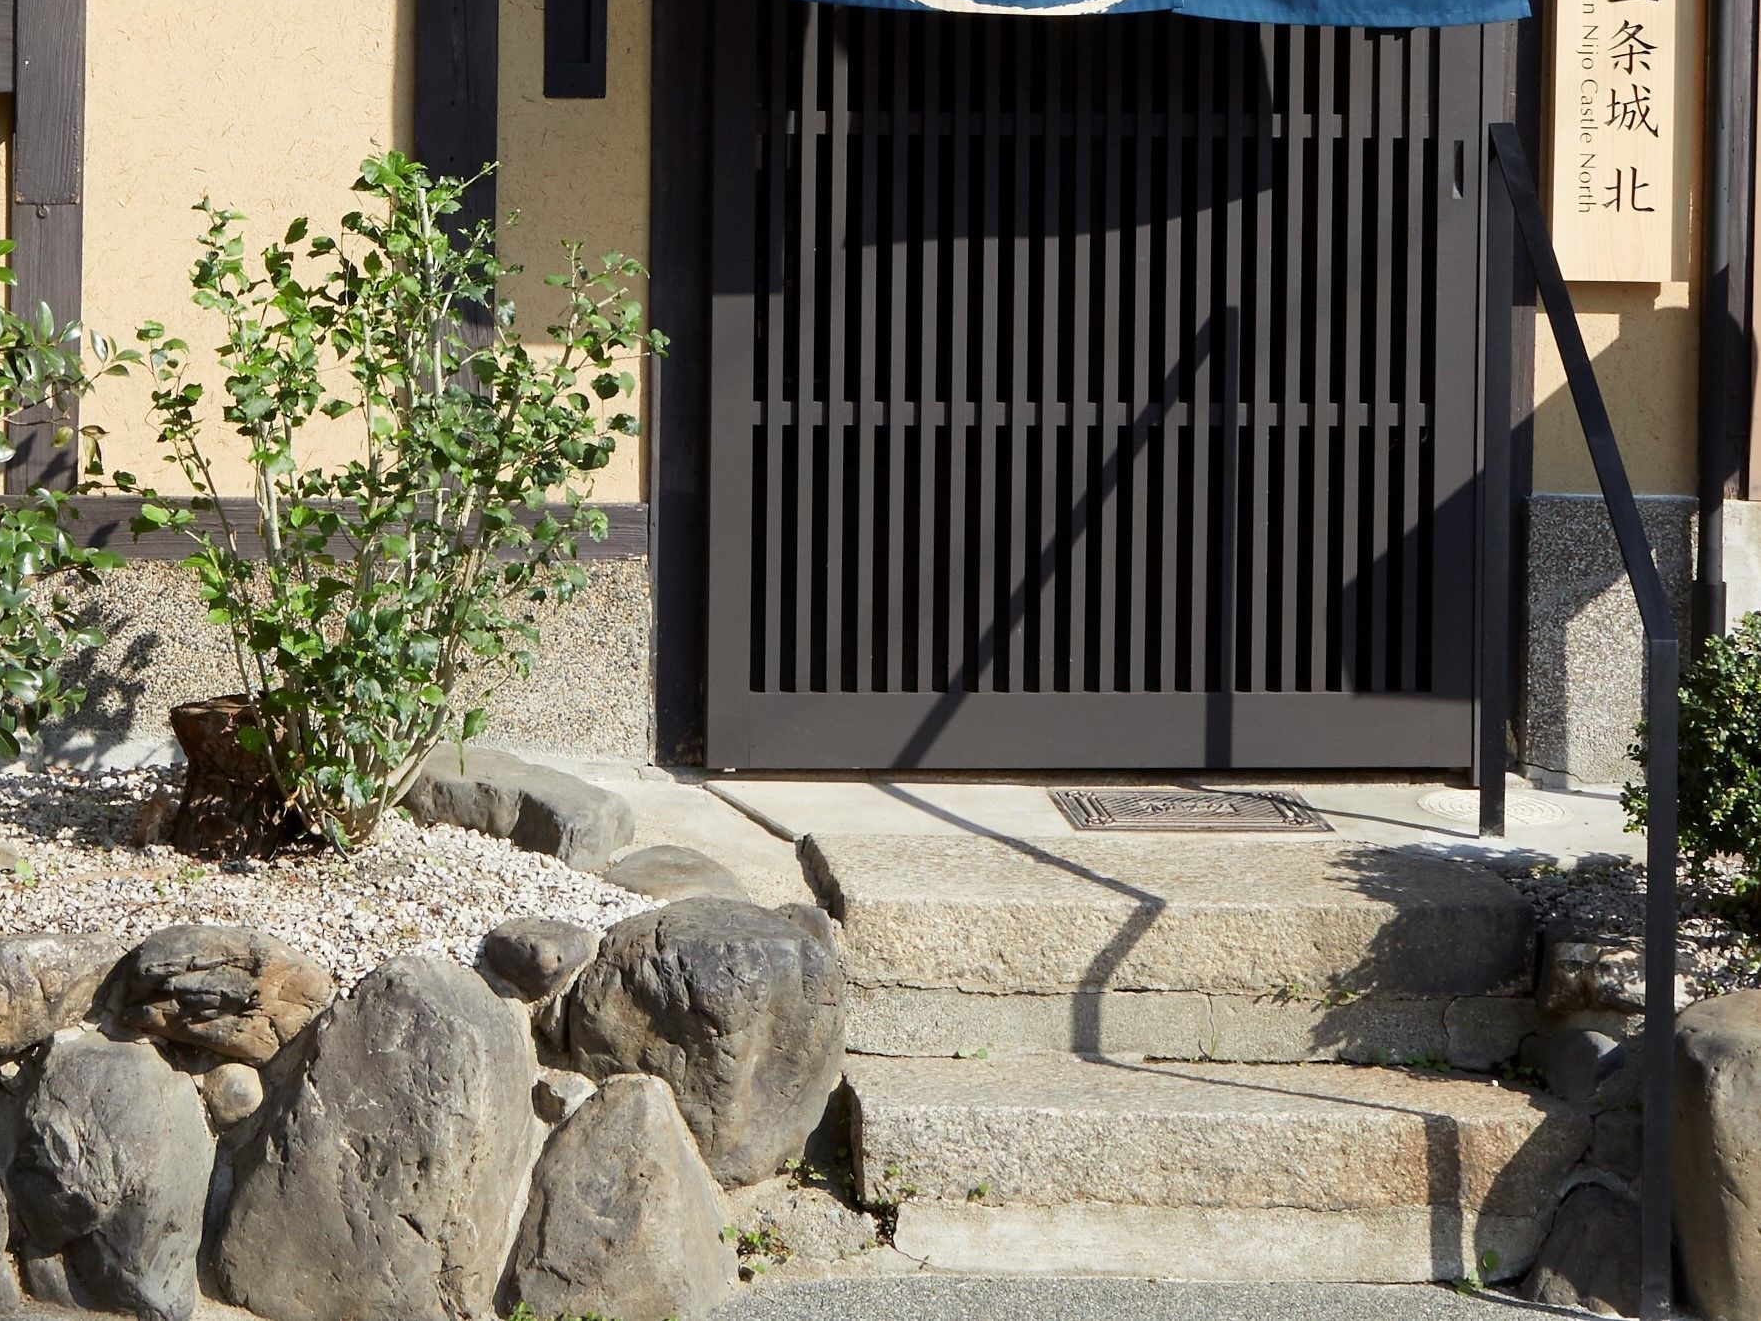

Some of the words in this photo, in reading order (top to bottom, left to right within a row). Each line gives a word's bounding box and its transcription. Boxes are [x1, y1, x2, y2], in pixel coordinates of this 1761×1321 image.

[1576, 25, 1599, 70] Nijo
[1579, 78, 1599, 144] Castle
[1577, 153, 1597, 214] North
